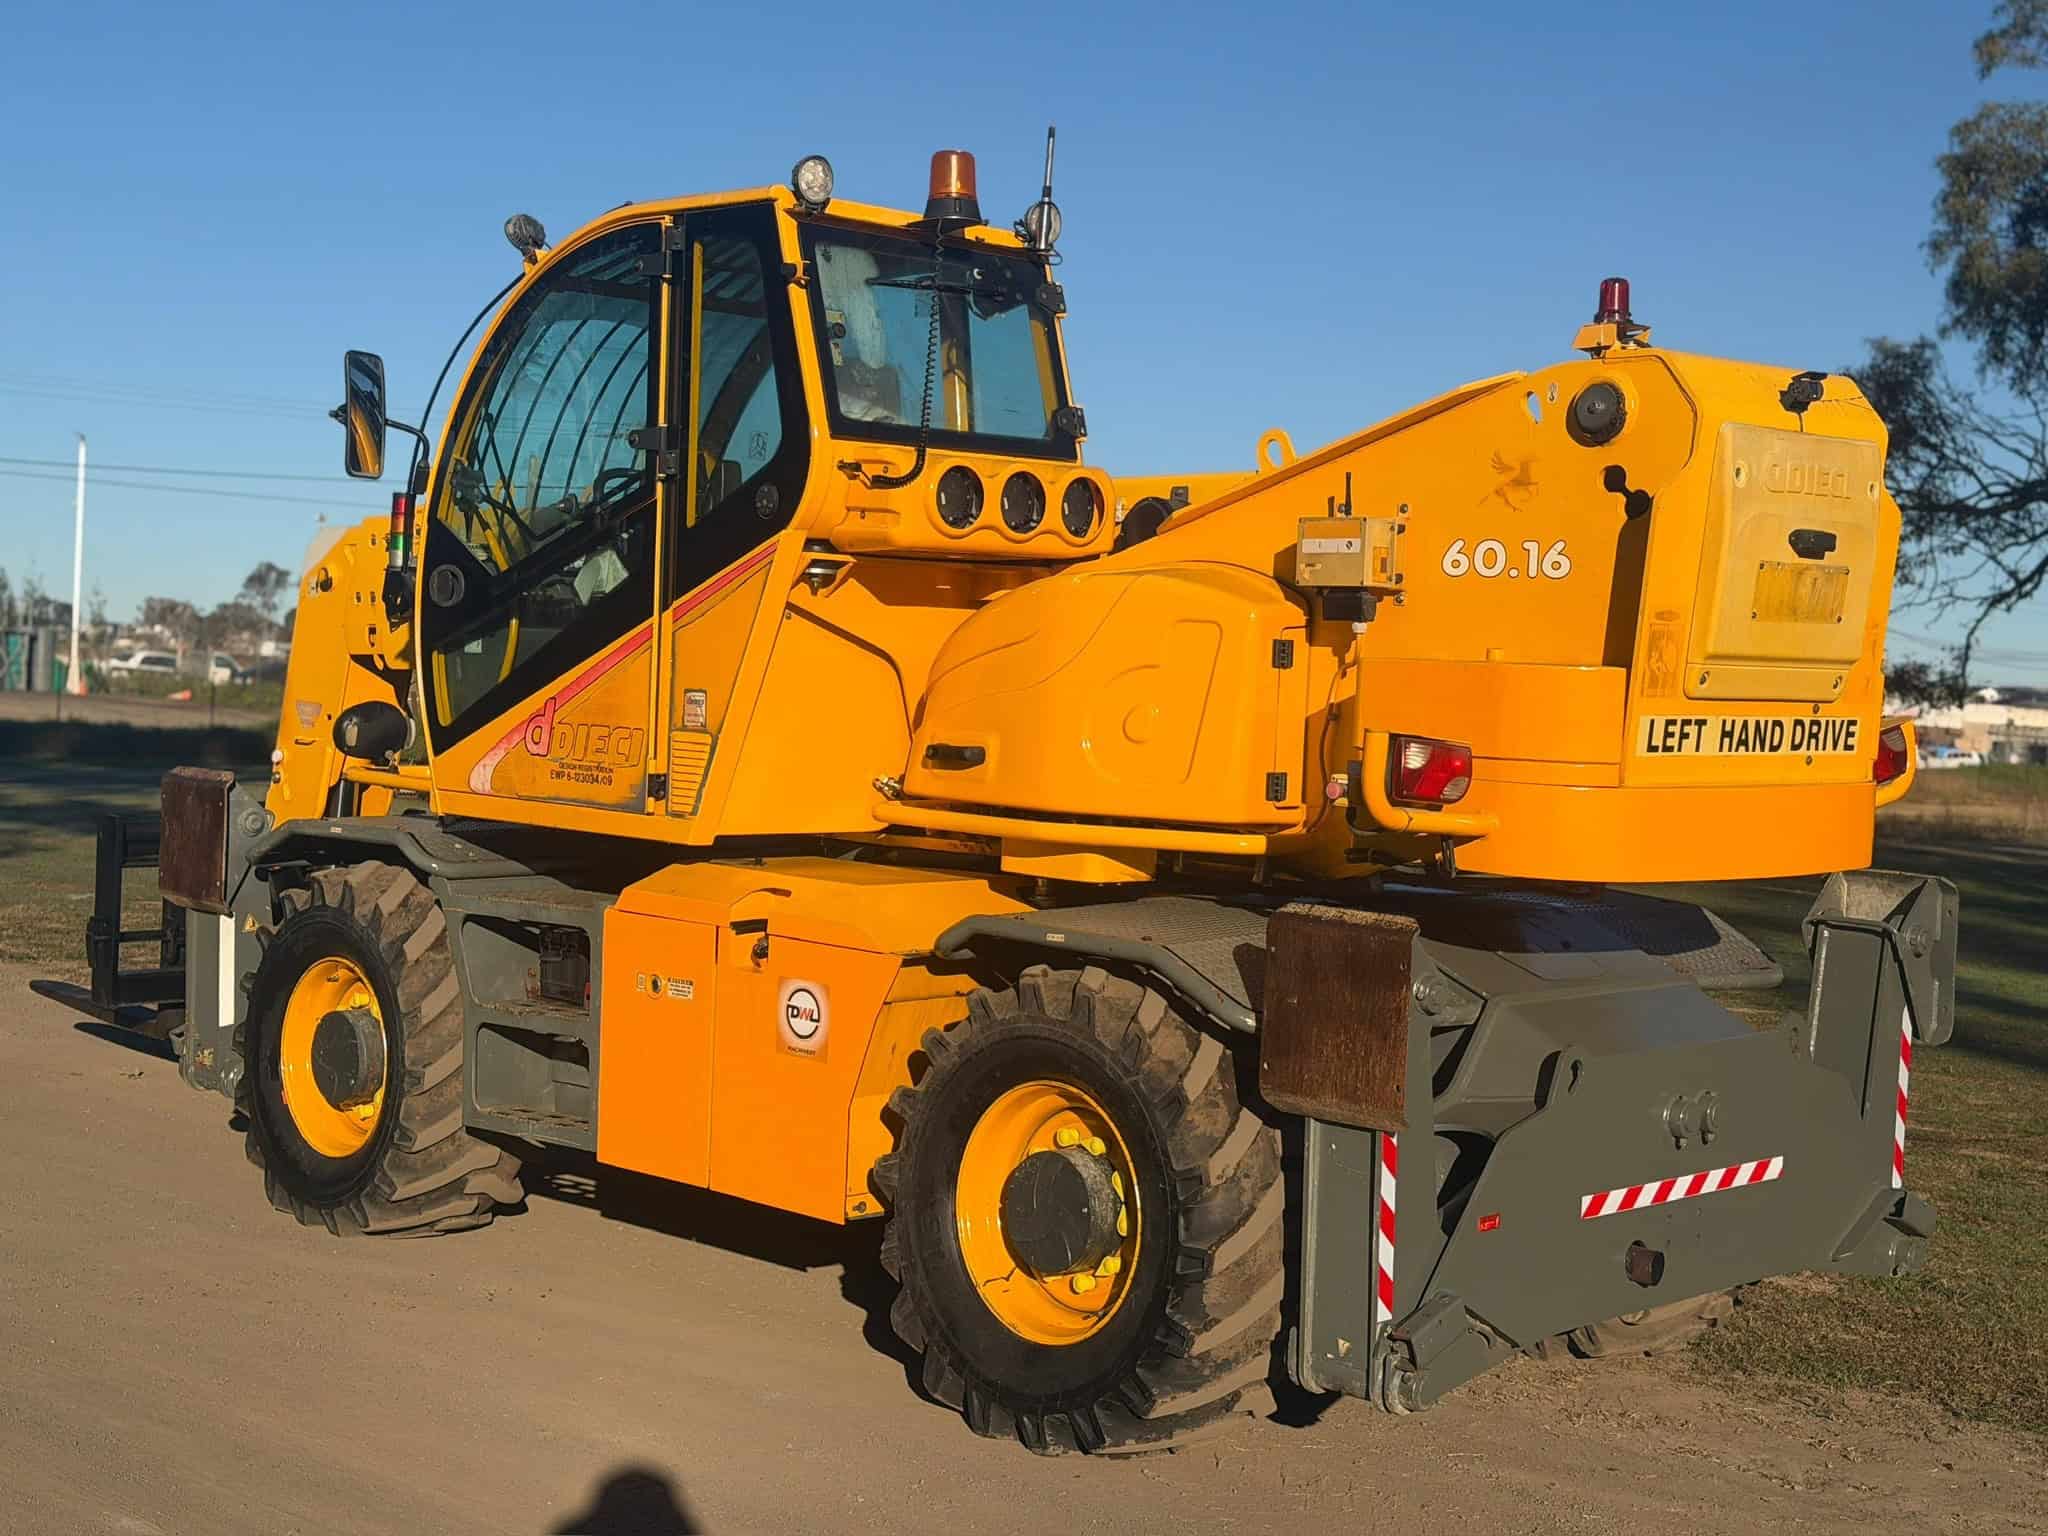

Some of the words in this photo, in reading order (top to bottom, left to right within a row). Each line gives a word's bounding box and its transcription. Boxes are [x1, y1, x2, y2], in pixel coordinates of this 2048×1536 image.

[1441, 538, 1572, 580] 60.16
[1646, 718, 1707, 753] LEFT
[1718, 718, 1785, 753] HAND
[1790, 718, 1858, 752] DRIVE
[550, 769, 566, 780] EWP
